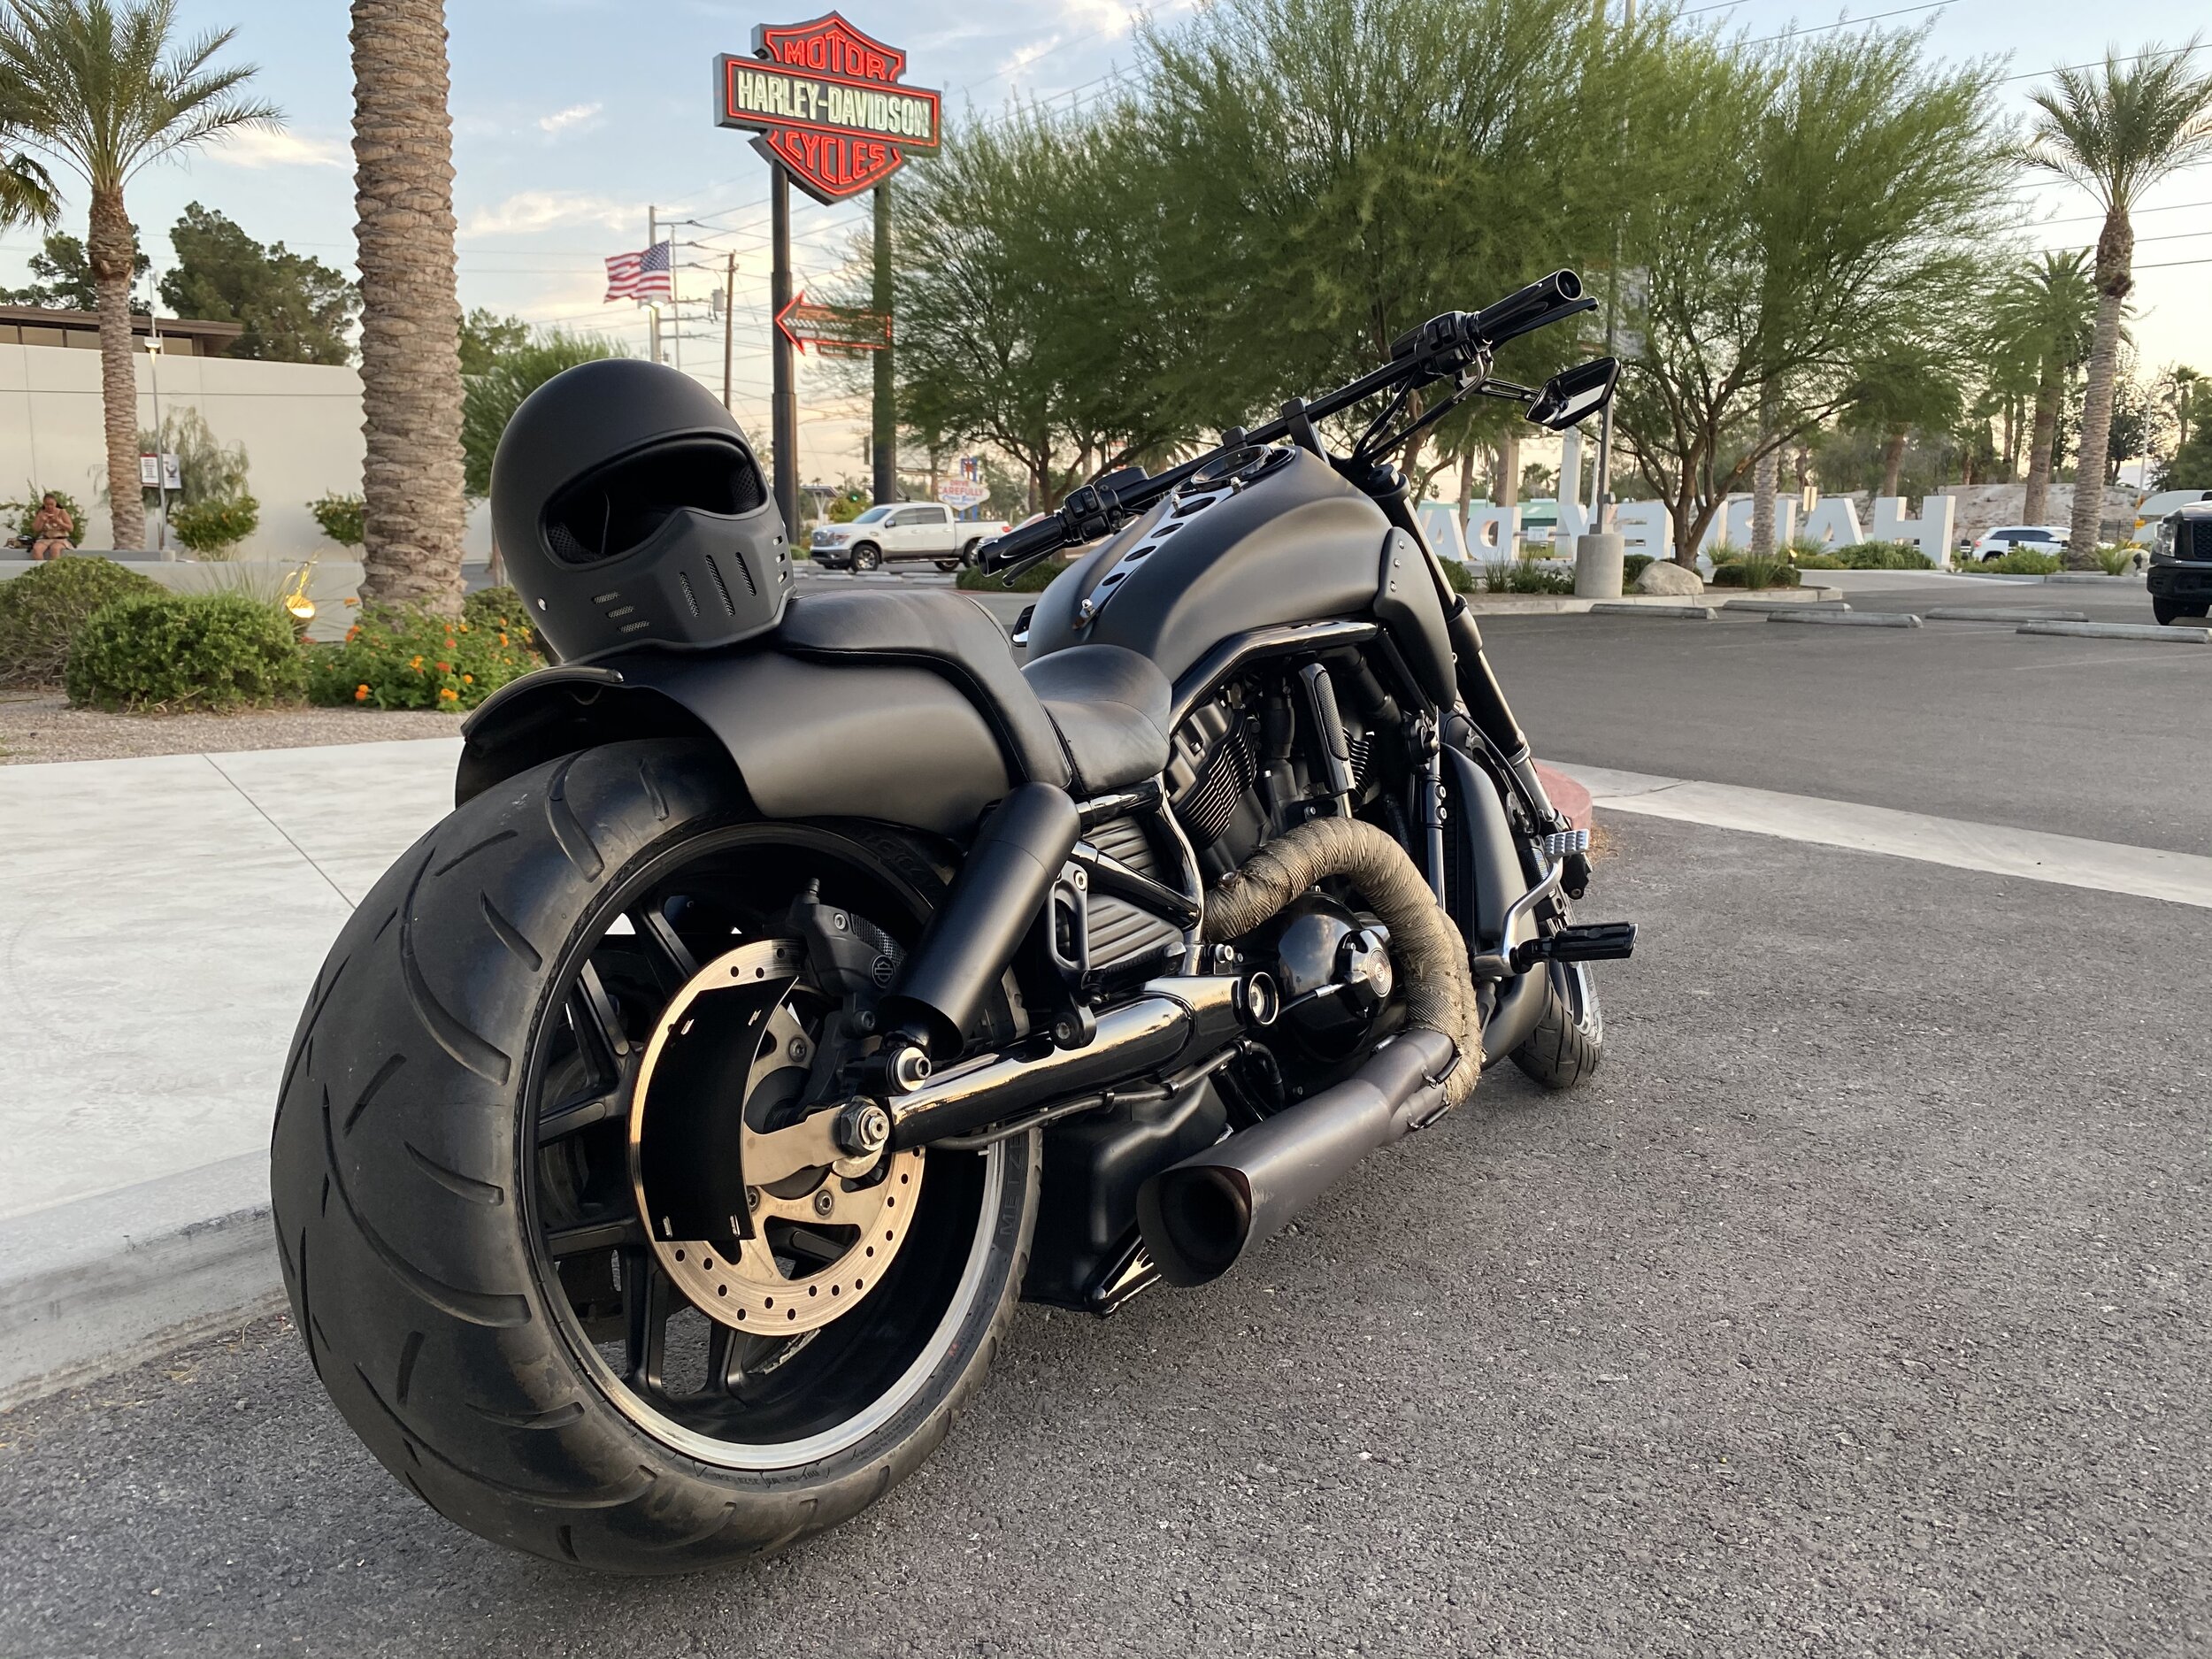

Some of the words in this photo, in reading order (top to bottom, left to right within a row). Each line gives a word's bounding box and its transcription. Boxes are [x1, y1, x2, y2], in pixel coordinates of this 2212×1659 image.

[784, 30, 886, 81] MOTOR
[737, 71, 930, 138] HARLEY-DAVIDSON
[784, 130, 886, 185] CYCLES
[938, 487, 983, 496] CAREFULLY
